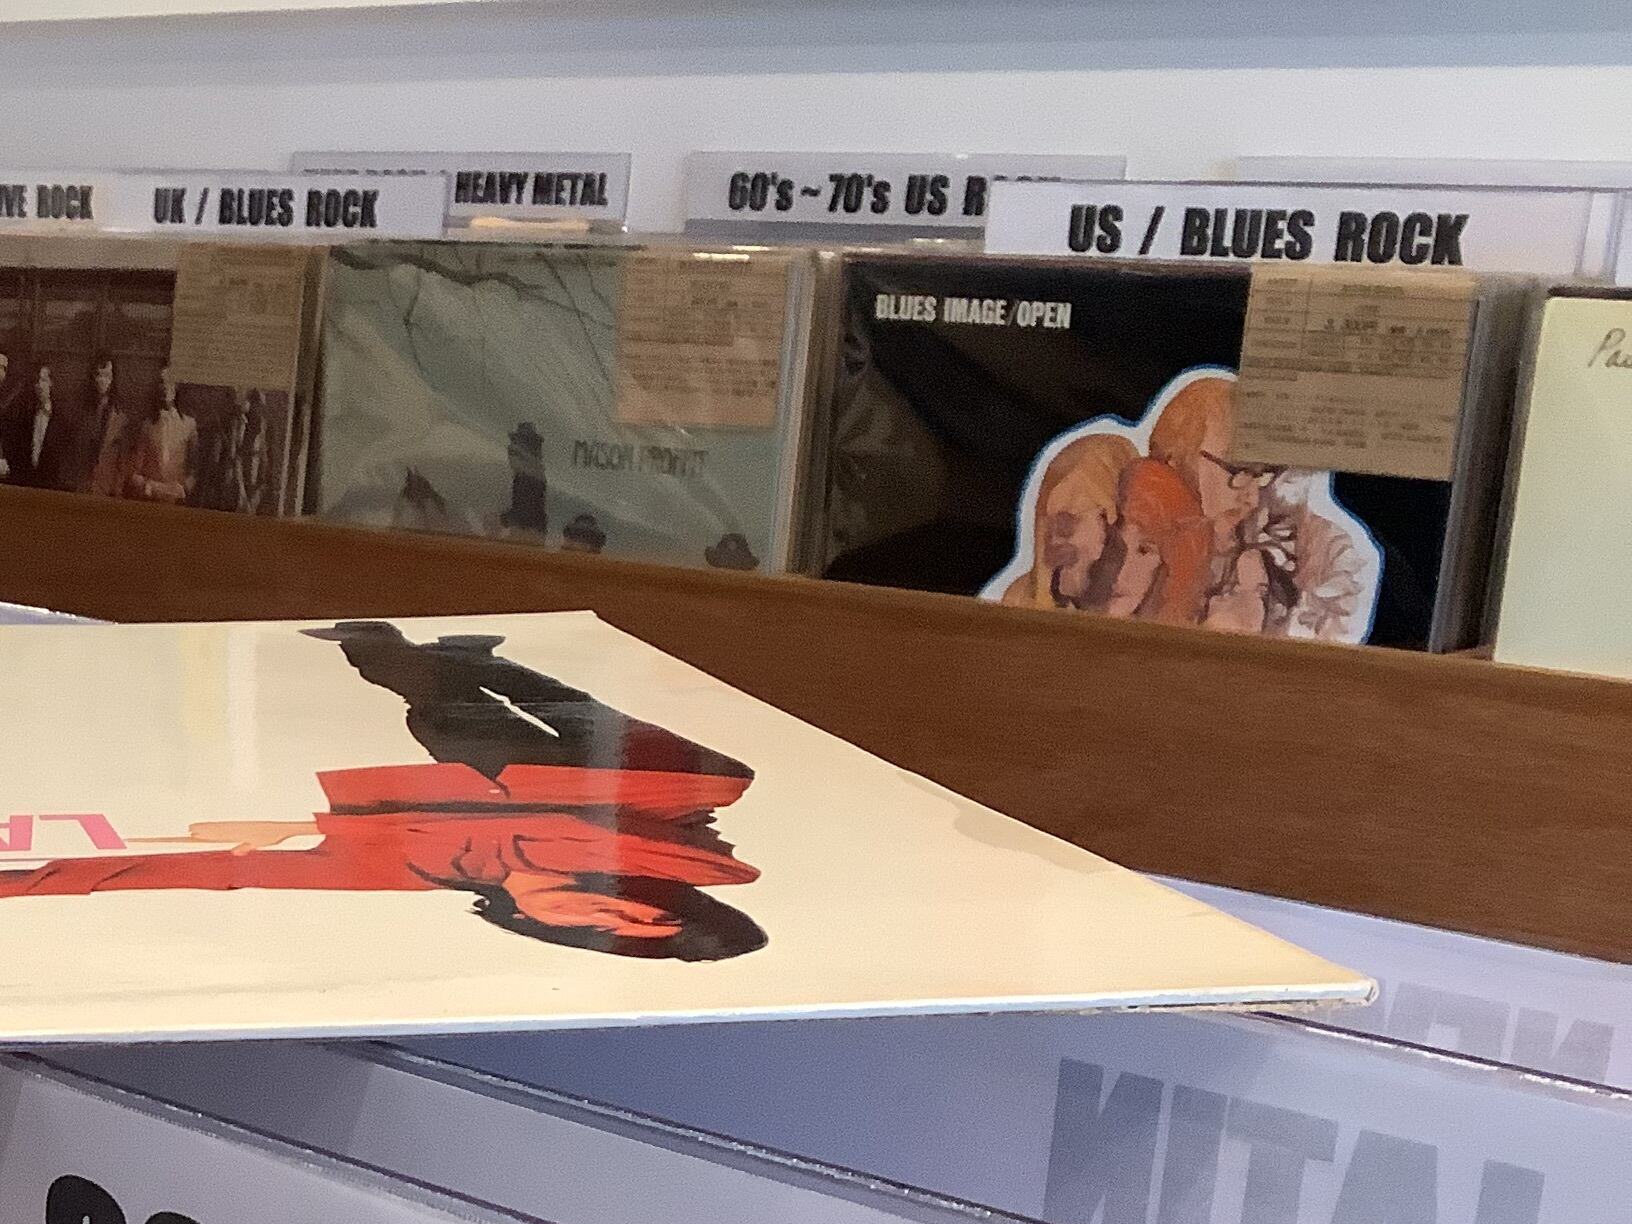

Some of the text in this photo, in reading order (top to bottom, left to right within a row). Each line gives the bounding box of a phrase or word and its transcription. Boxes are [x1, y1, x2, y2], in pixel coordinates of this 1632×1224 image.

[37, 184, 94, 219] ROCK
[154, 187, 186, 224] UK
[218, 188, 294, 226] BLUES
[306, 188, 379, 228] ROCK
[455, 171, 608, 207] HEAVY METAL
[728, 172, 795, 212] 60's
[828, 173, 892, 214] 70's
[905, 174, 951, 216] US
[1069, 203, 1124, 254] US
[1180, 206, 1316, 261] BLUES
[1334, 210, 1471, 266] ROCK
[876, 294, 937, 322] BLUES
